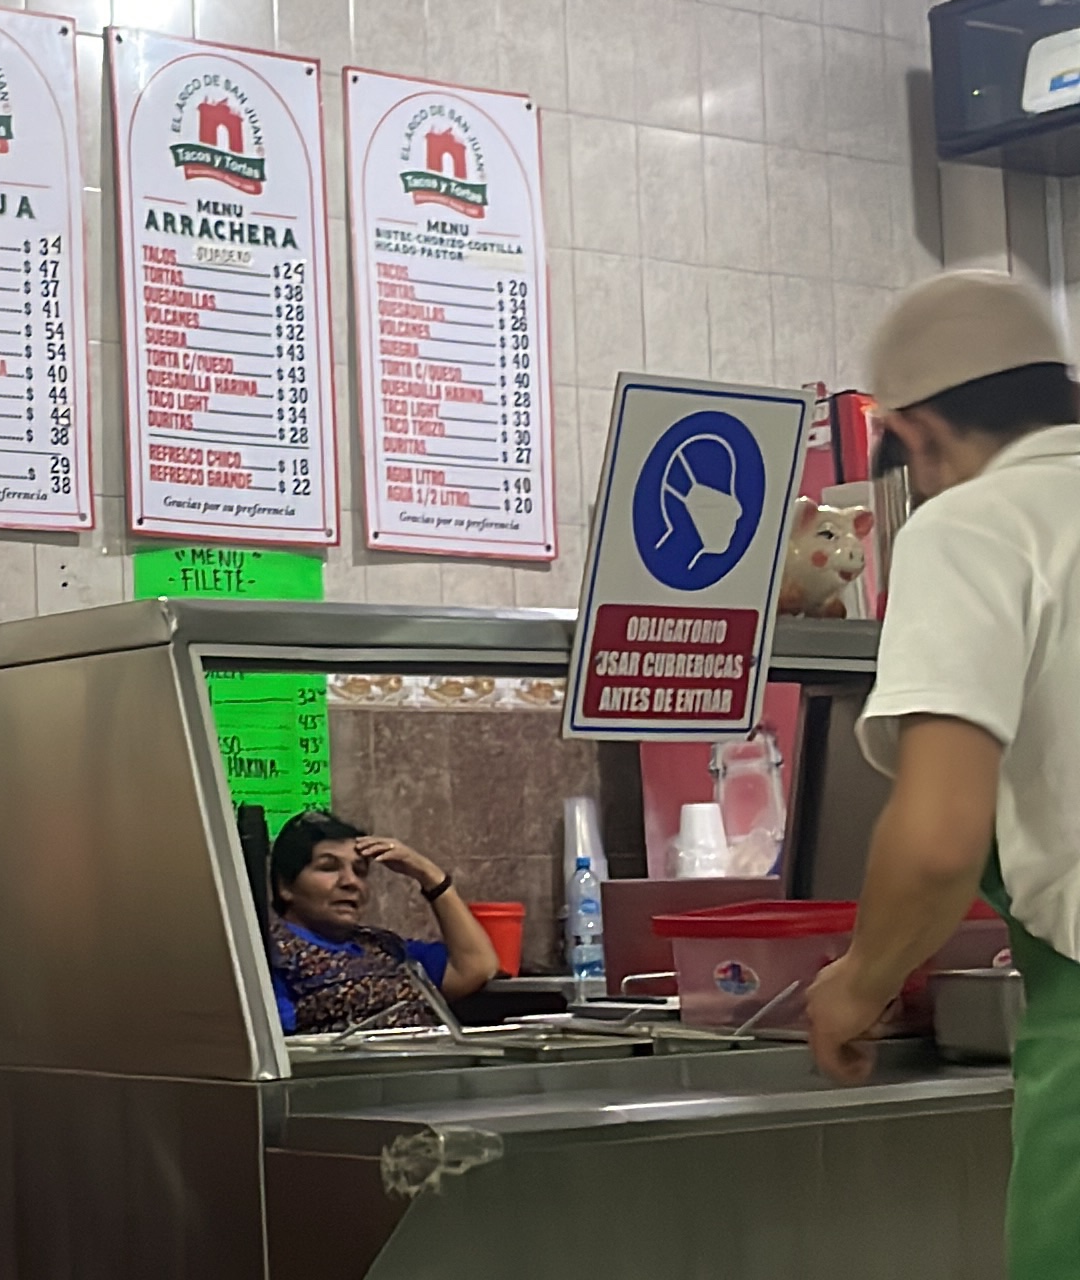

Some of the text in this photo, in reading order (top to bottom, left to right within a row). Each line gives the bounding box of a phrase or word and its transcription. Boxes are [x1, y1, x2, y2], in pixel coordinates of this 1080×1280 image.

[170, 116, 182, 133] EL
[203, 74, 220, 87] DE
[223, 78, 248, 105] SAN
[244, 107, 263, 146] JUAN
[176, 148, 260, 179] Tacos y Tortas
[197, 198, 244, 218] MENU
[144, 209, 299, 250] ARRACHERA
[426, 219, 469, 236] MENU
[23, 239, 31, 254] $
[39, 235, 62, 256] 34
[142, 244, 177, 266] TACOS
[24, 259, 31, 274] $
[39, 259, 59, 279] 47
[143, 265, 184, 287] TORTAS
[24, 280, 31, 295] $
[40, 280, 59, 298] 37
[143, 285, 216, 311] QUESADILLAS
[509, 280, 527, 298] 20
[24, 301, 32, 316] $
[42, 300, 60, 319] 41
[144, 305, 200, 329] VOLCANES
[510, 298, 526, 317] 34
[25, 322, 64, 341] $ 54
[512, 334, 529, 350] 30
[24, 343, 66, 362] $ 54
[512, 353, 530, 369] 40
[25, 364, 68, 383] $ 40
[146, 348, 179, 369] TORTA
[288, 366, 305, 384] 43
[147, 369, 211, 393] QUESADILLA
[288, 387, 308, 404] 30
[515, 372, 530, 389] 40
[26, 386, 68, 405] $ 44
[513, 391, 531, 408] 28
[26, 406, 34, 421] $
[148, 389, 174, 409] TACO
[178, 393, 209, 412] LIGHT
[288, 406, 307, 425] 34
[513, 410, 530, 427] 33
[25, 427, 69, 446] $ 38
[290, 426, 309, 444] 28
[514, 429, 531, 446] 30
[149, 443, 203, 466] REFRESCO
[207, 449, 241, 469] CHICO
[292, 459, 309, 476] 18
[516, 447, 531, 464] 27
[50, 456, 70, 475] 29
[51, 476, 71, 494] 38
[150, 464, 204, 486] REFRESCO
[207, 470, 253, 490] GRANDE
[292, 478, 311, 496] 22
[514, 477, 531, 494] 40
[163, 495, 295, 517] Gracias por su preferencia
[515, 497, 532, 514] 20
[436, 518, 452, 528] por
[627, 616, 727, 644] OBLIGATORIO
[642, 652, 743, 679] CUBREBOCAS
[598, 686, 733, 713] ANTES DE ENTRAR
